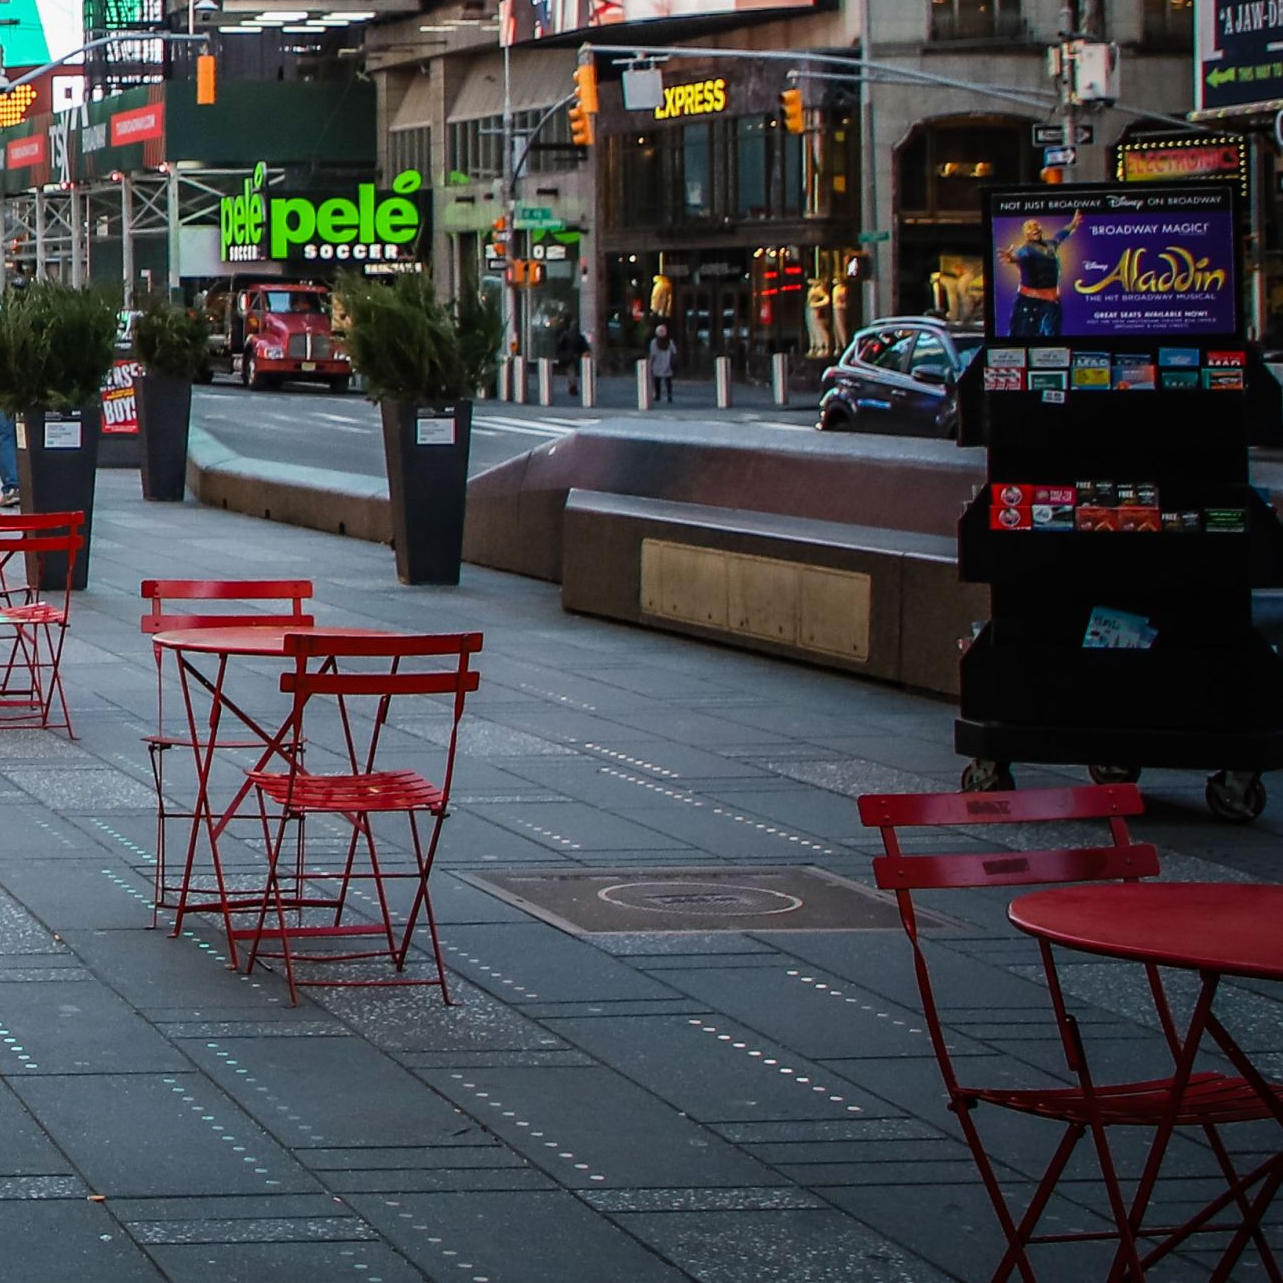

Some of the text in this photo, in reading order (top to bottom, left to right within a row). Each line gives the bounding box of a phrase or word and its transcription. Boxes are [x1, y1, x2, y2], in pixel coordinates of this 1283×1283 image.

[1126, 147, 1237, 174] ELECTRONICS
[220, 161, 267, 262] pelé
[1000, 195, 1222, 211] NOT JUST BROADWAY Disney ON BROADWAY
[271, 169, 423, 259] pelé
[230, 246, 257, 261] SOCCER
[305, 243, 399, 260] SOCCER
[1074, 247, 1226, 294] Aladdin
[1122, 294, 1174, 302] BROADWAY
[1176, 293, 1216, 302] MUSICAL
[1185, 310, 1209, 318] NOW!
